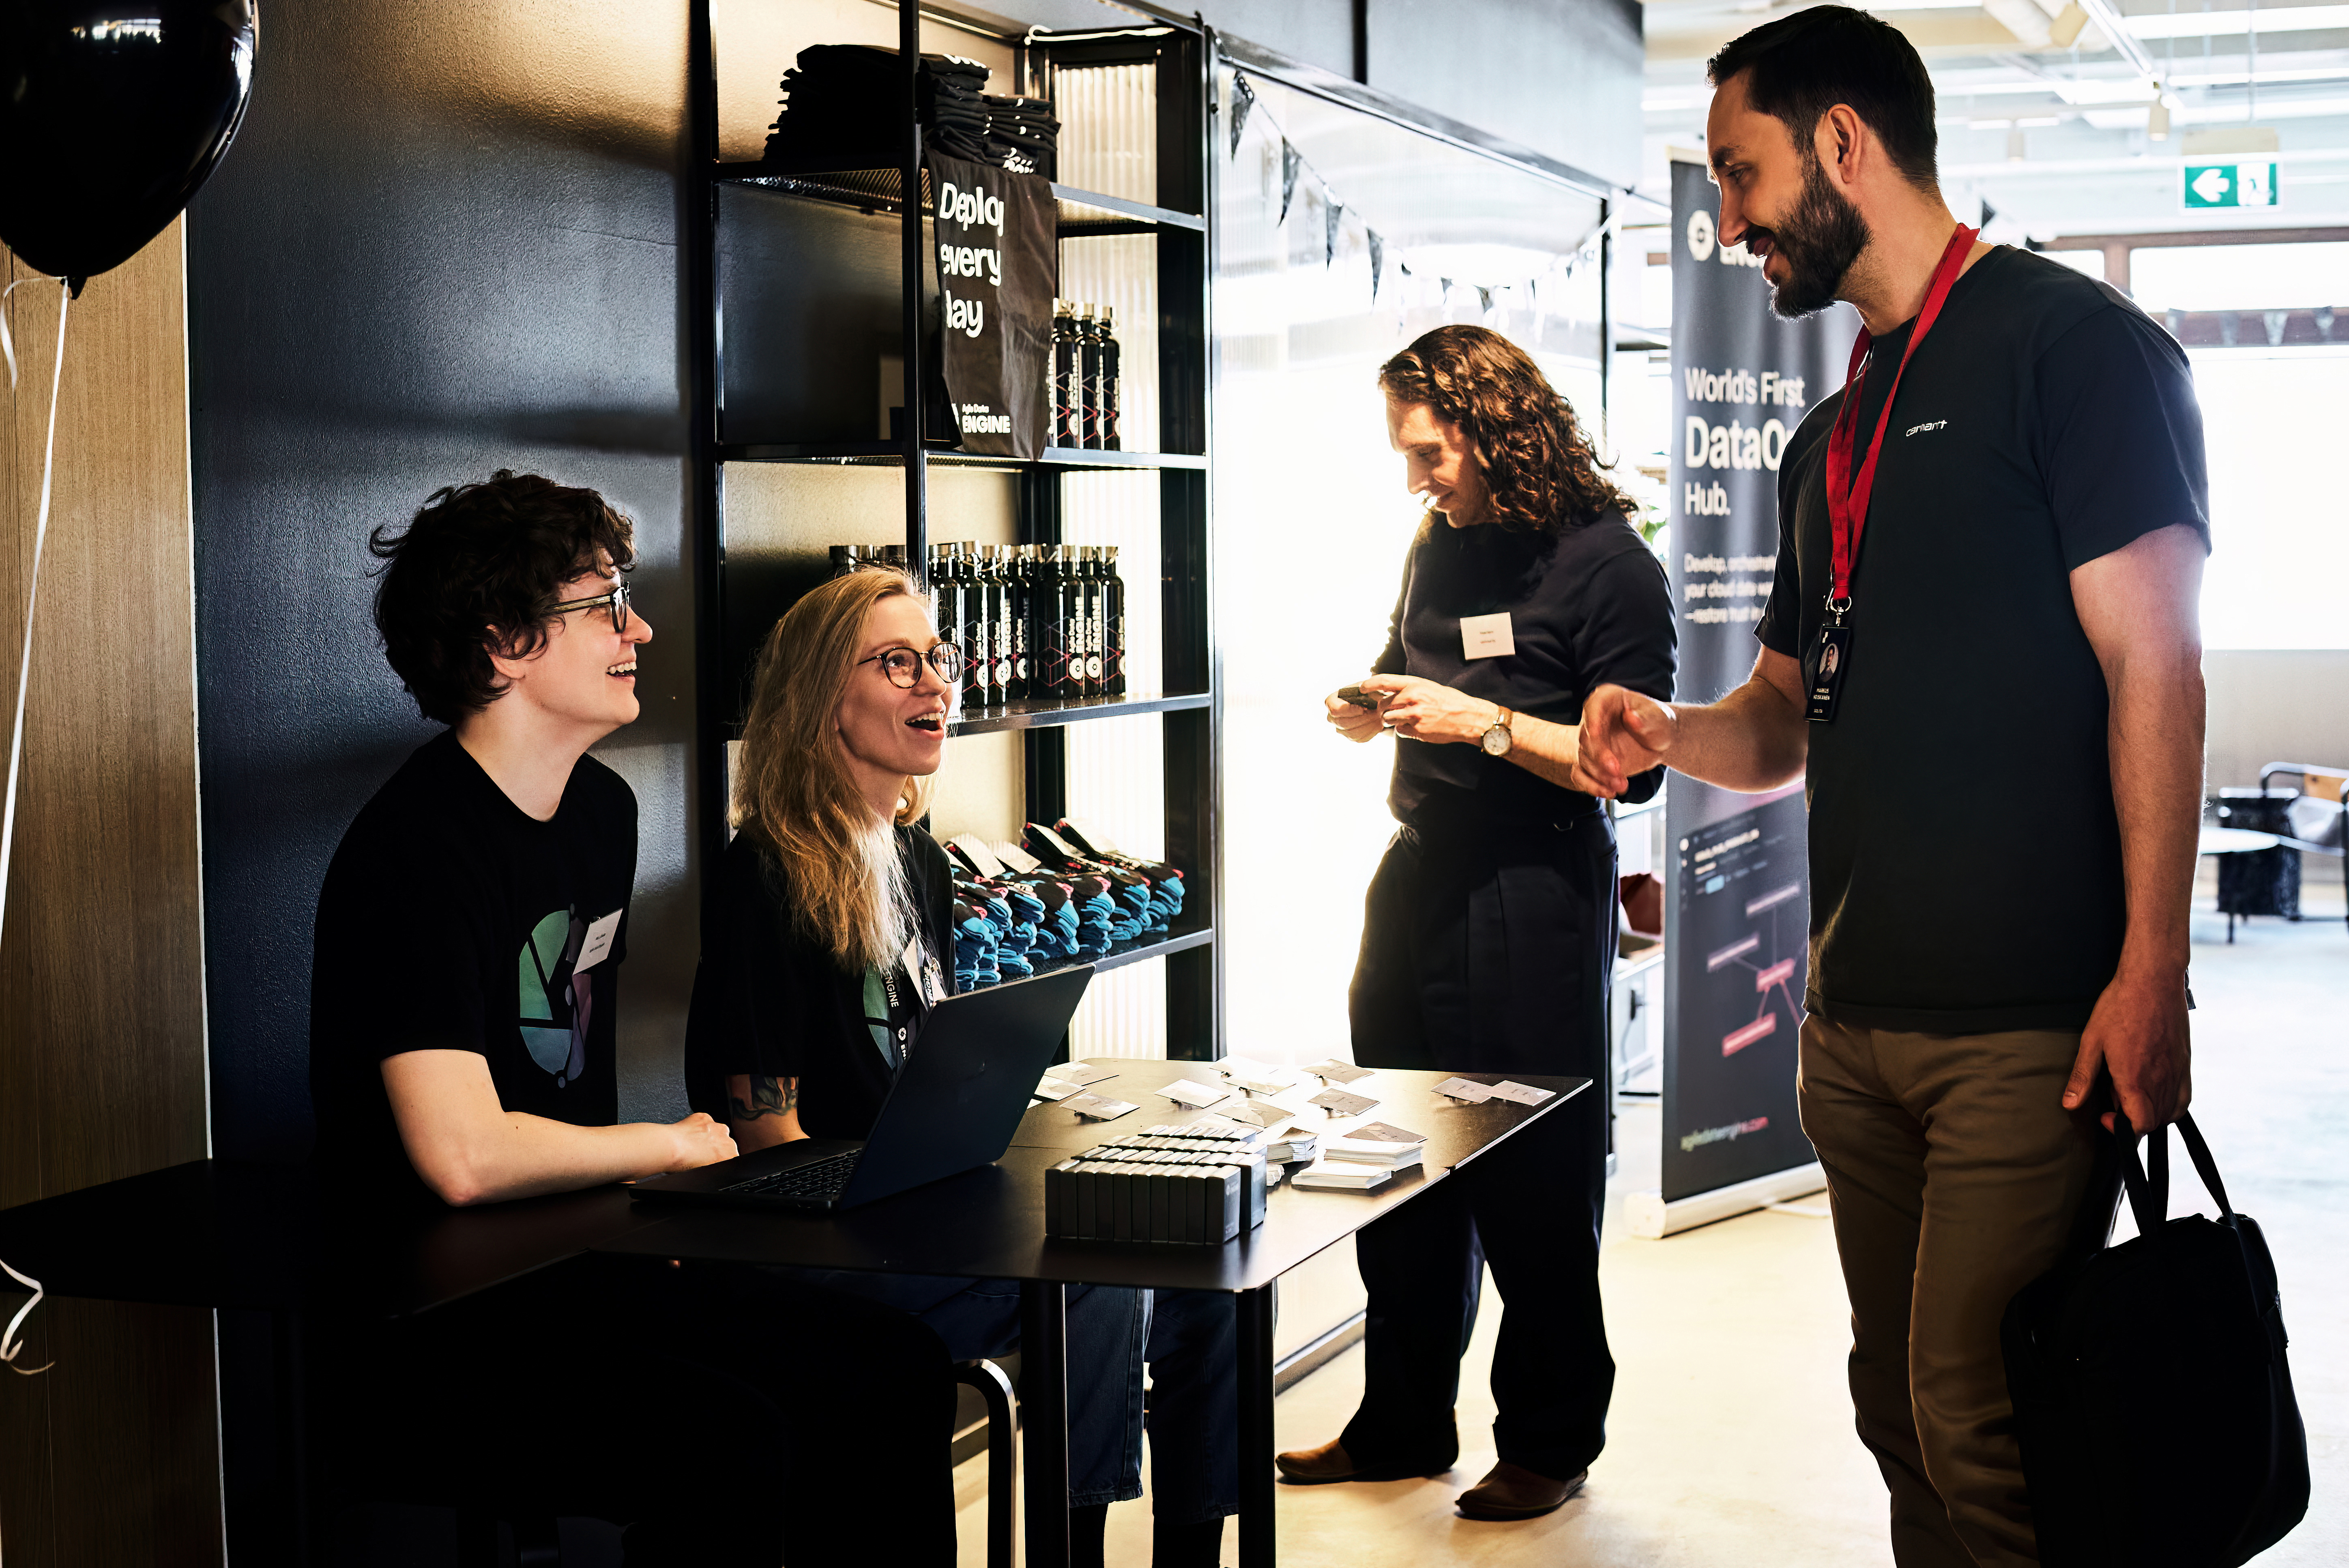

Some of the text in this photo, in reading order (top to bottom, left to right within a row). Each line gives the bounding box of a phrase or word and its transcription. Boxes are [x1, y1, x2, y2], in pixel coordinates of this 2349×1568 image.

[940, 243, 1001, 286] every
[1685, 367, 1805, 408] World's First
[962, 415, 1010, 433] ENGINE
[1685, 480, 1731, 516] Hub.
[1076, 596, 1084, 653] ENGINE
[1092, 596, 1101, 652] ENGINE
[885, 976, 899, 1008] NGINE
